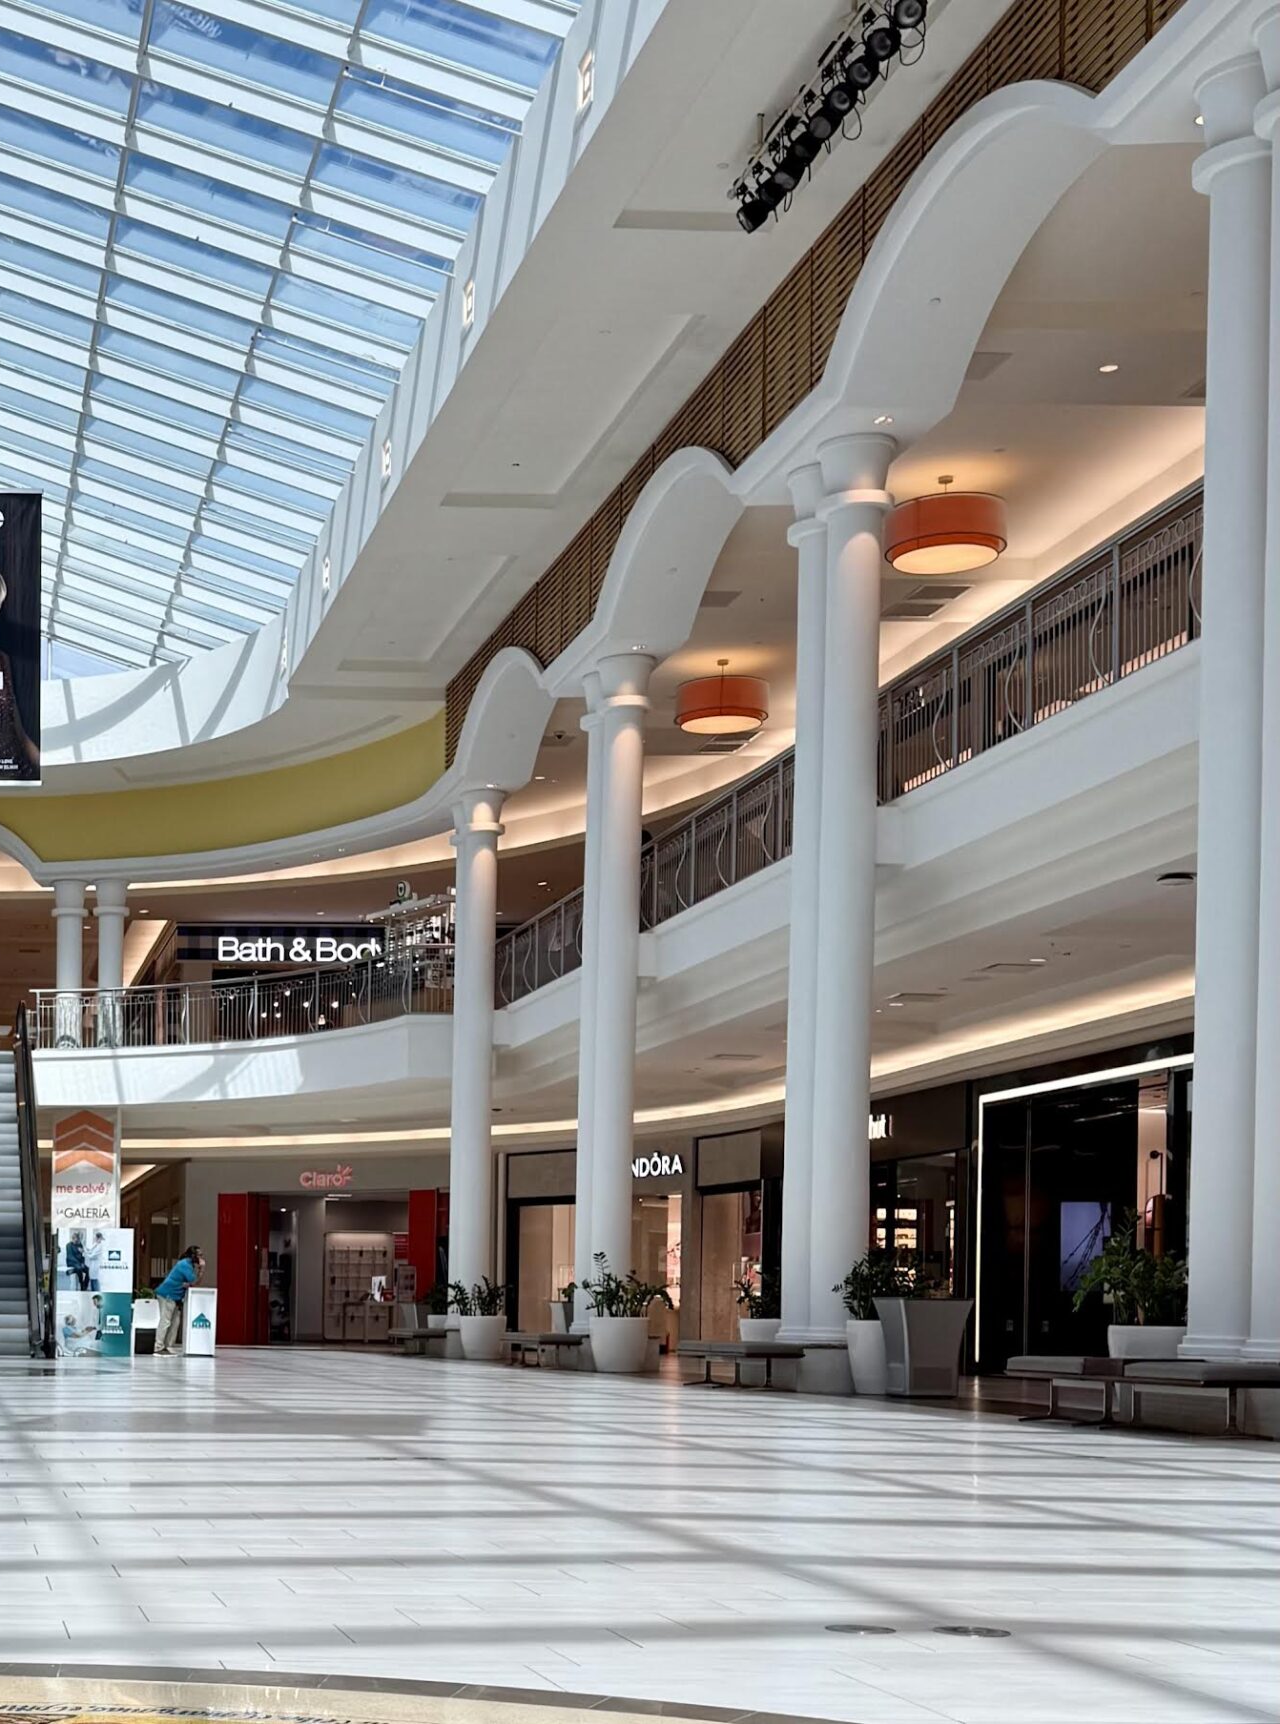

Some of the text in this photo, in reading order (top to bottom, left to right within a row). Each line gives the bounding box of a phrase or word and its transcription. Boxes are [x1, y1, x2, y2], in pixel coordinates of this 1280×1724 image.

[218, 937, 284, 962] Bath
[289, 937, 312, 962] &
[300, 1170, 344, 1187] Claro
[56, 1185, 73, 1193] me
[64, 1204, 110, 1218] GALERÍA
